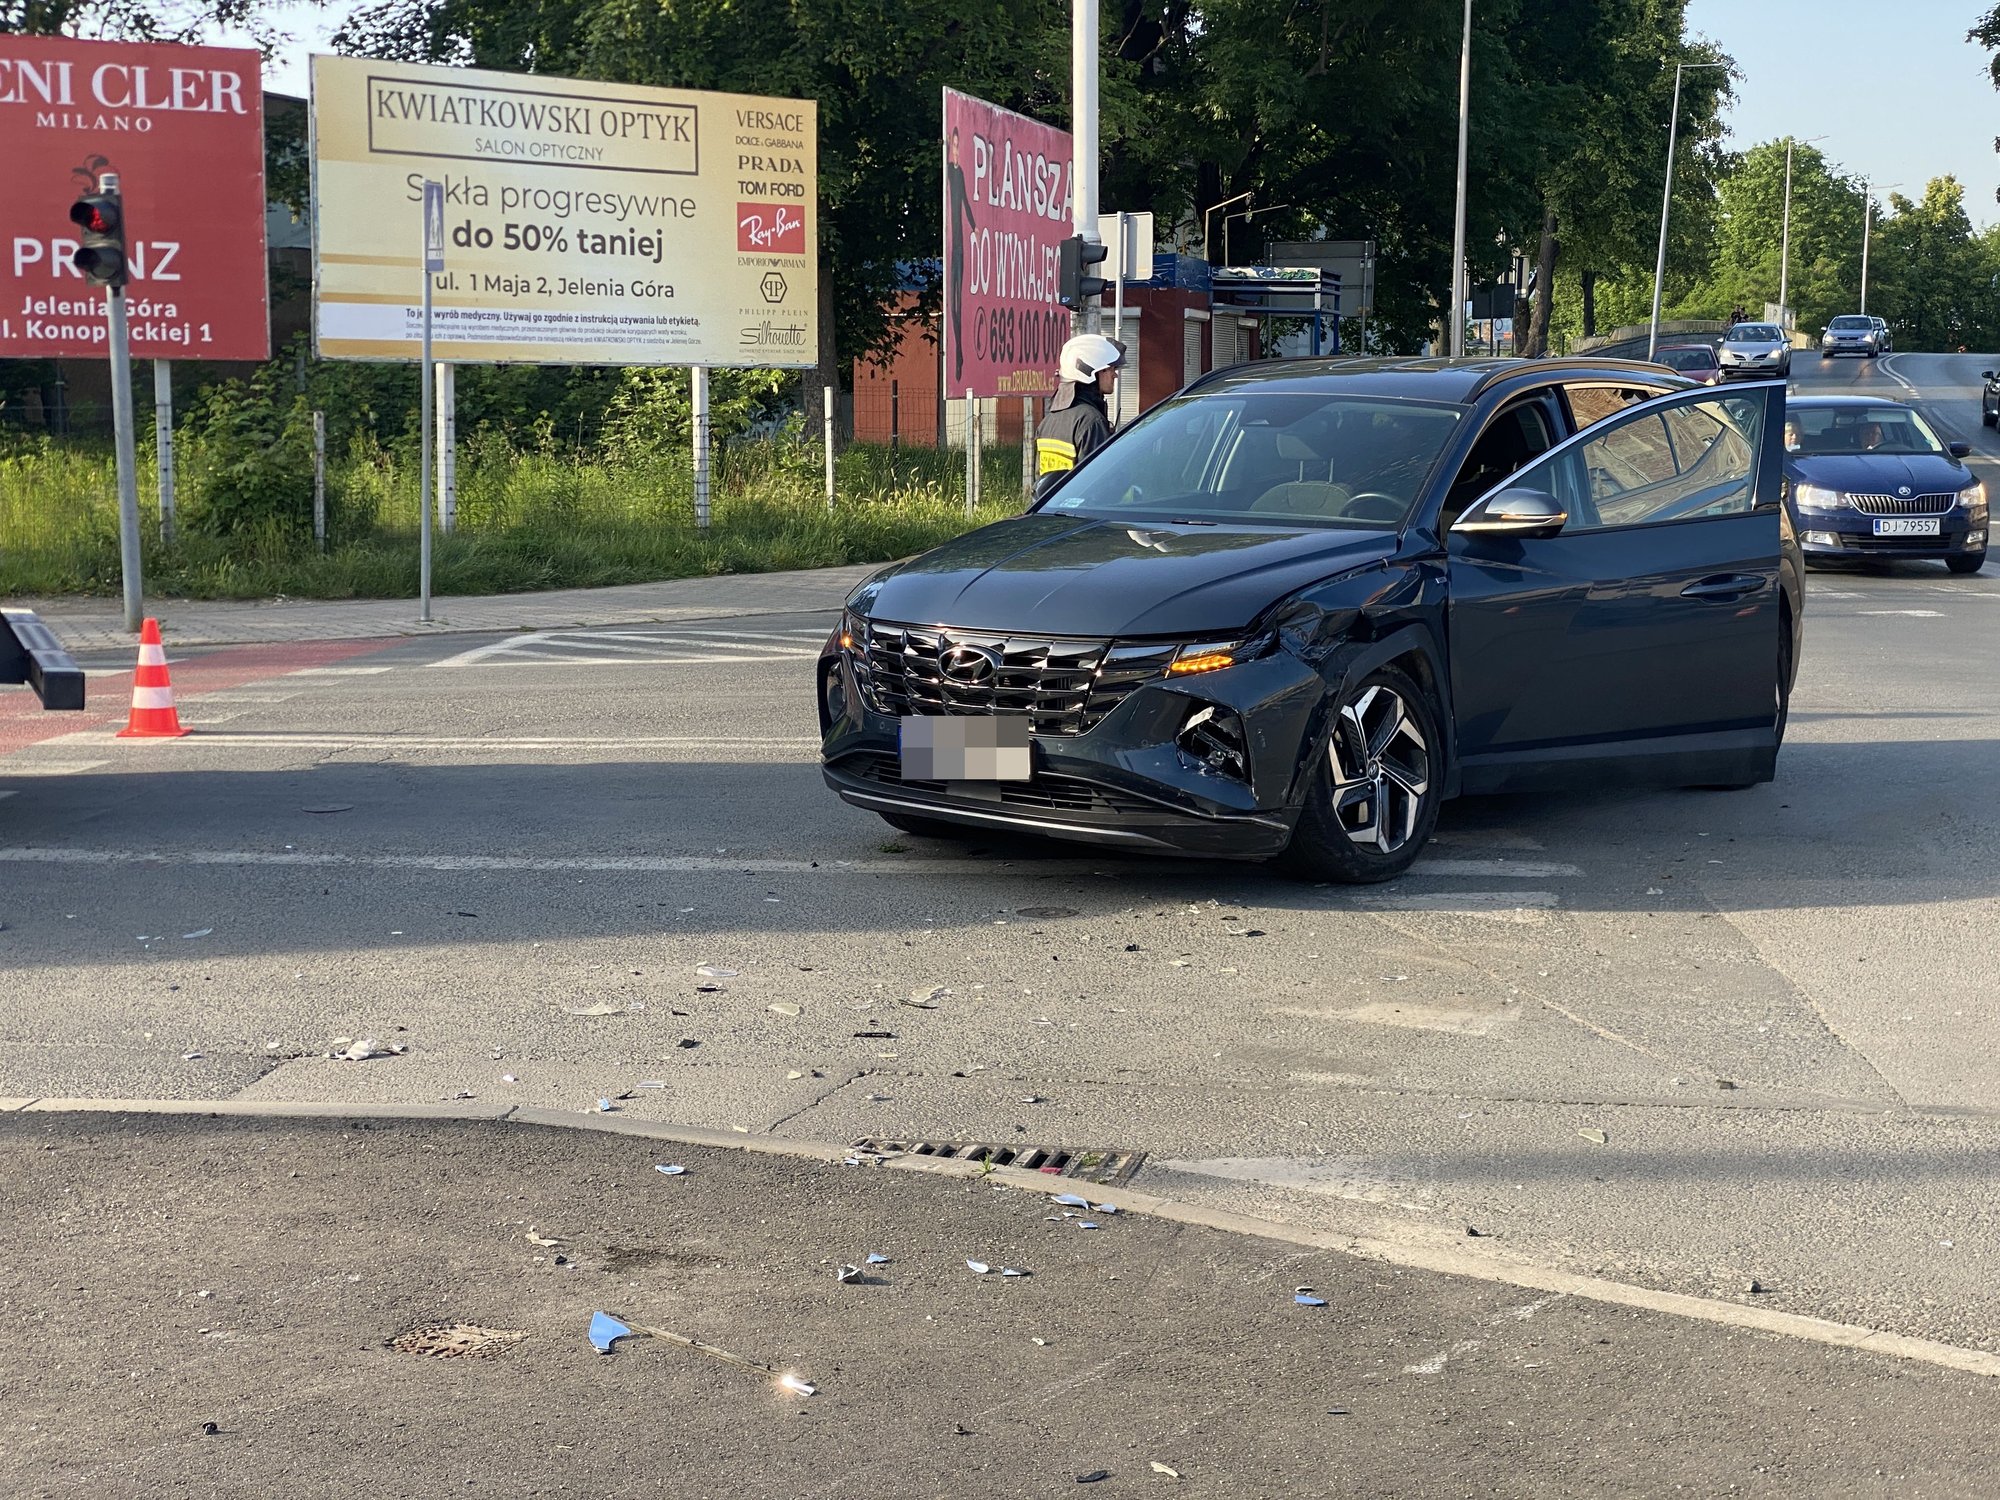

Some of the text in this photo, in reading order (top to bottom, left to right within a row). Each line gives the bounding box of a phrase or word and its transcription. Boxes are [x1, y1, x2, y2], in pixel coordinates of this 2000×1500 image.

[92, 63, 247, 115] CLER
[36, 111, 152, 132] MILANO
[376, 89, 691, 142] KWIATKOWSKI OPTYK
[736, 109, 803, 132] VERSACE
[475, 137, 604, 161] SALON OPTYCZNY
[738, 155, 804, 174] PRADA
[737, 180, 805, 197] TOM FORD
[973, 133, 1073, 223] PLANSZA
[406, 173, 697, 222] Skła progresywne
[452, 219, 663, 264] do 50% taniej
[14, 237, 181, 281] PRNZ
[970, 227, 991, 295] DO
[436, 272, 674, 298] ul. 1 Maja 2, Jelenia Góra
[21, 296, 110, 317] Jelenia
[406, 308, 416, 318] To
[434, 309, 459, 320] wyrób
[461, 310, 502, 322] medyczny.
[503, 311, 532, 323] Używaj
[532, 314, 542, 323] go
[544, 313, 573, 324] zgodnie
[574, 315, 579, 323] z
[580, 313, 619, 326] instrukcją
[619, 315, 655, 326] używania
[656, 315, 668, 325] lub
[668, 316, 701, 327] etykietą.
[739, 308, 777, 316] PHILIPP
[26, 320, 191, 345] Konopckiej
[199, 323, 213, 342] 1
[739, 320, 807, 346] Silhouette
[990, 306, 1067, 364] 693 100 000
[1882, 520, 1938, 533] DJ 79557
